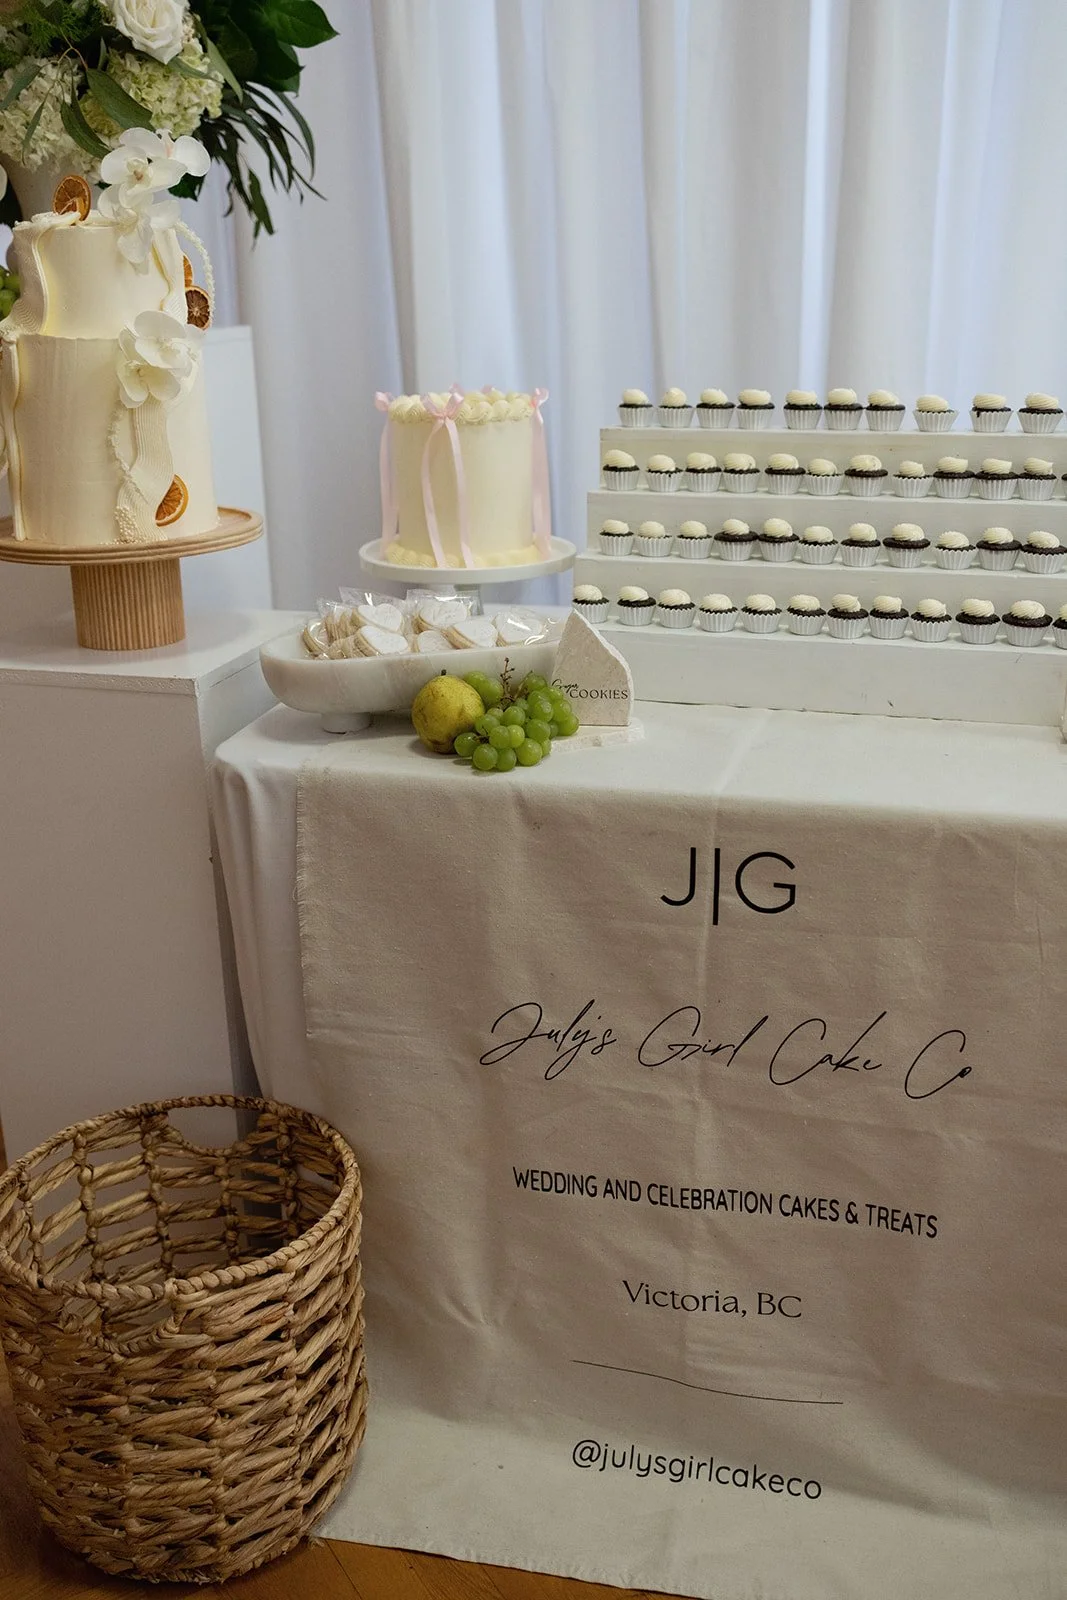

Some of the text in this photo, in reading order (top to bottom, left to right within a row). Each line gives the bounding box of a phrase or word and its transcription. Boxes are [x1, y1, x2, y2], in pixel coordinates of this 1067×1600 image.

[569, 688, 629, 700] COOKIES
[480, 999, 973, 1100] July's Girl Cake Co
[513, 1166, 938, 1239] WEDDING AND CELEBRATION CAKES & TREATS
[622, 1280, 802, 1319] Victoria, BC
[572, 1440, 822, 1500] @julysgirlcakeco
